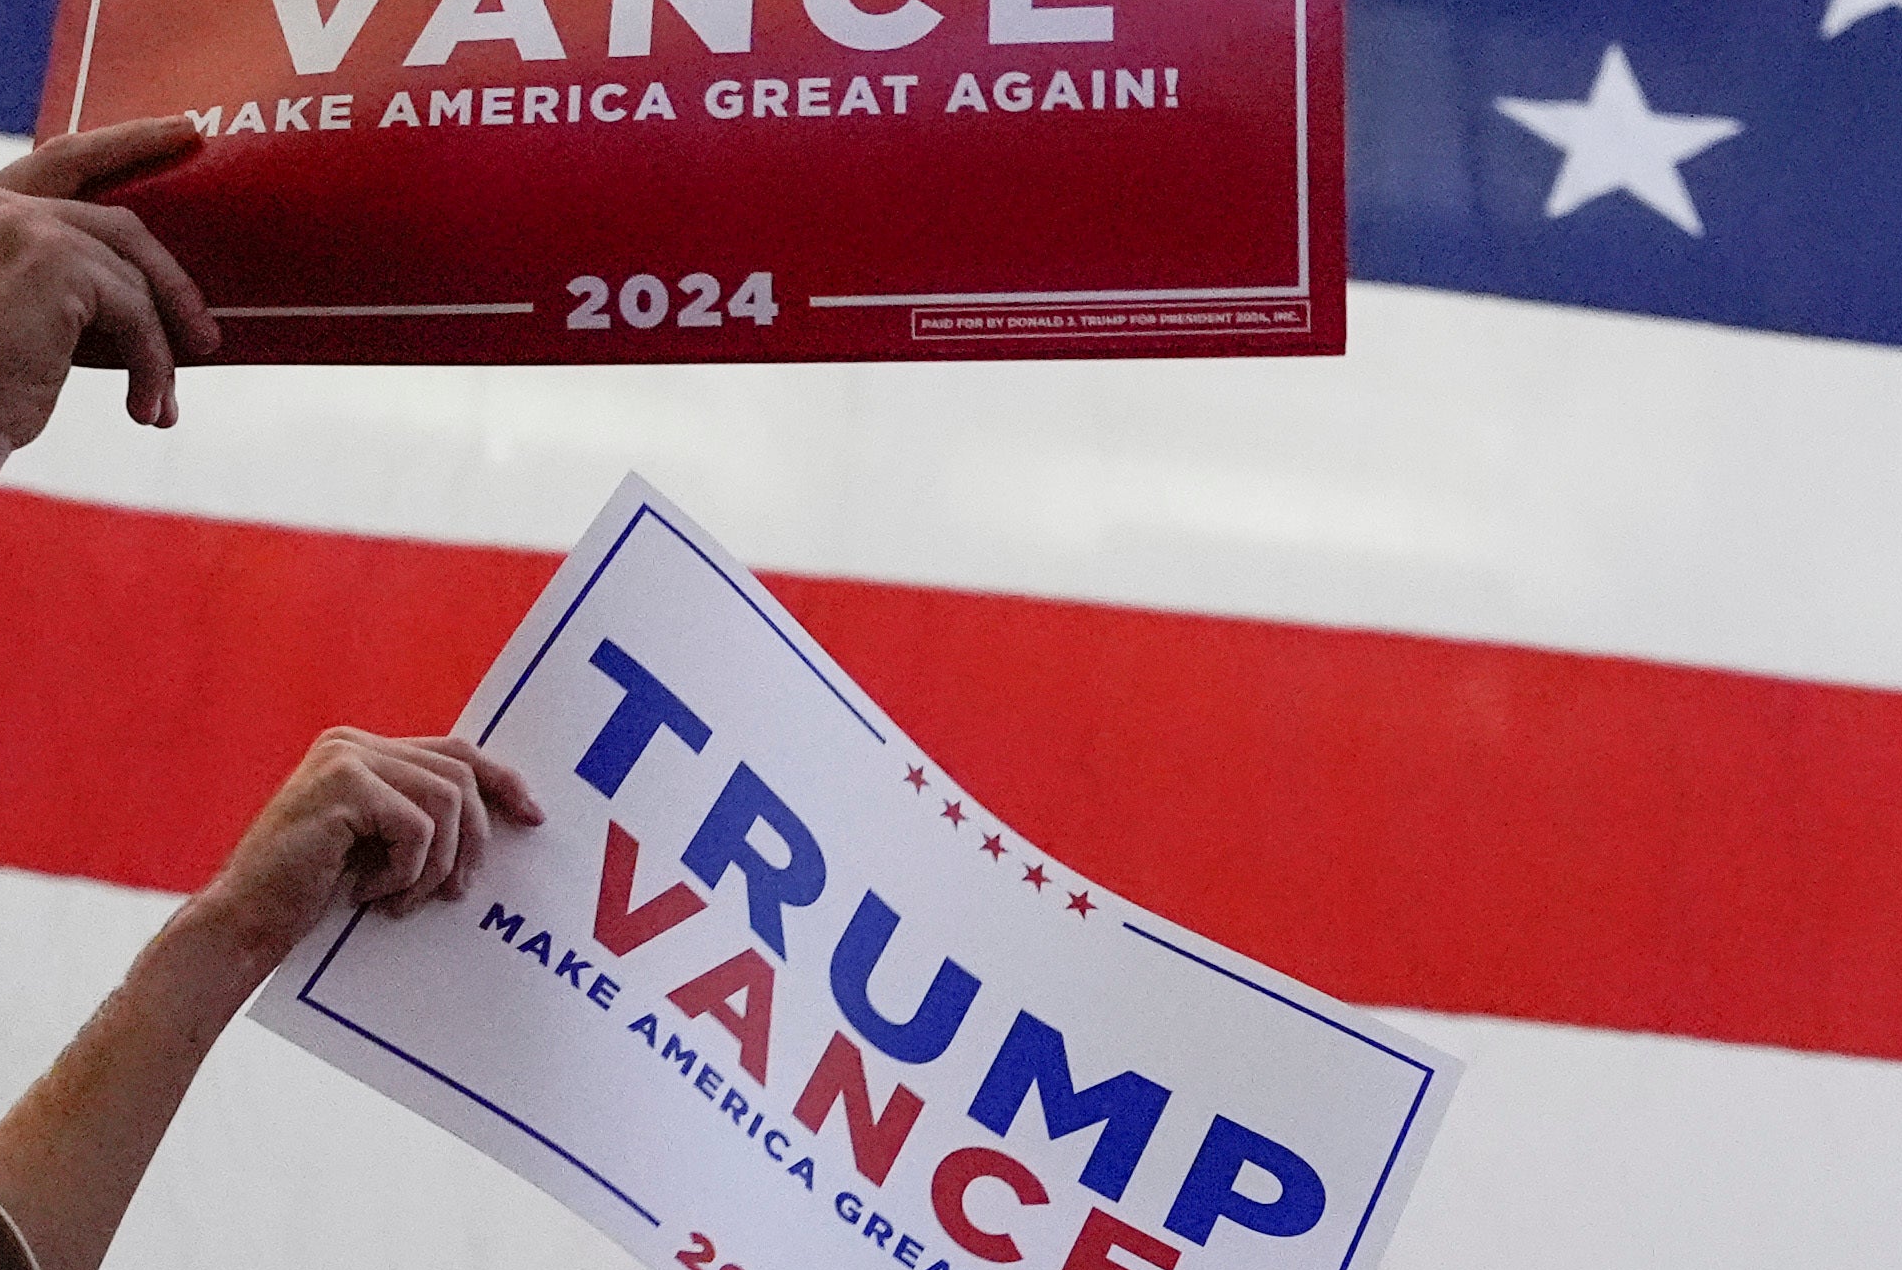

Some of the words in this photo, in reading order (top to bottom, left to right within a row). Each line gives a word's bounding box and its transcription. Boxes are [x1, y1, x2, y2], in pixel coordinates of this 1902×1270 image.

[184, 93, 353, 138] MAKE
[381, 83, 674, 126] AMERICA
[705, 75, 918, 118] GREAT
[947, 69, 1177, 111] AGAIN!
[570, 274, 776, 326] 2024
[921, 318, 954, 329] PAID
[956, 318, 984, 329] FOR
[986, 317, 1004, 328] BY
[1007, 316, 1064, 328] DONALD
[1080, 314, 1127, 327] TRUMP
[1129, 314, 1157, 325] FOR
[1159, 312, 1234, 325] PRESIDENT
[571, 636, 1328, 1248] TRUMP
[479, 902, 621, 1011] MAKE
[627, 1013, 816, 1191] AMERICA
